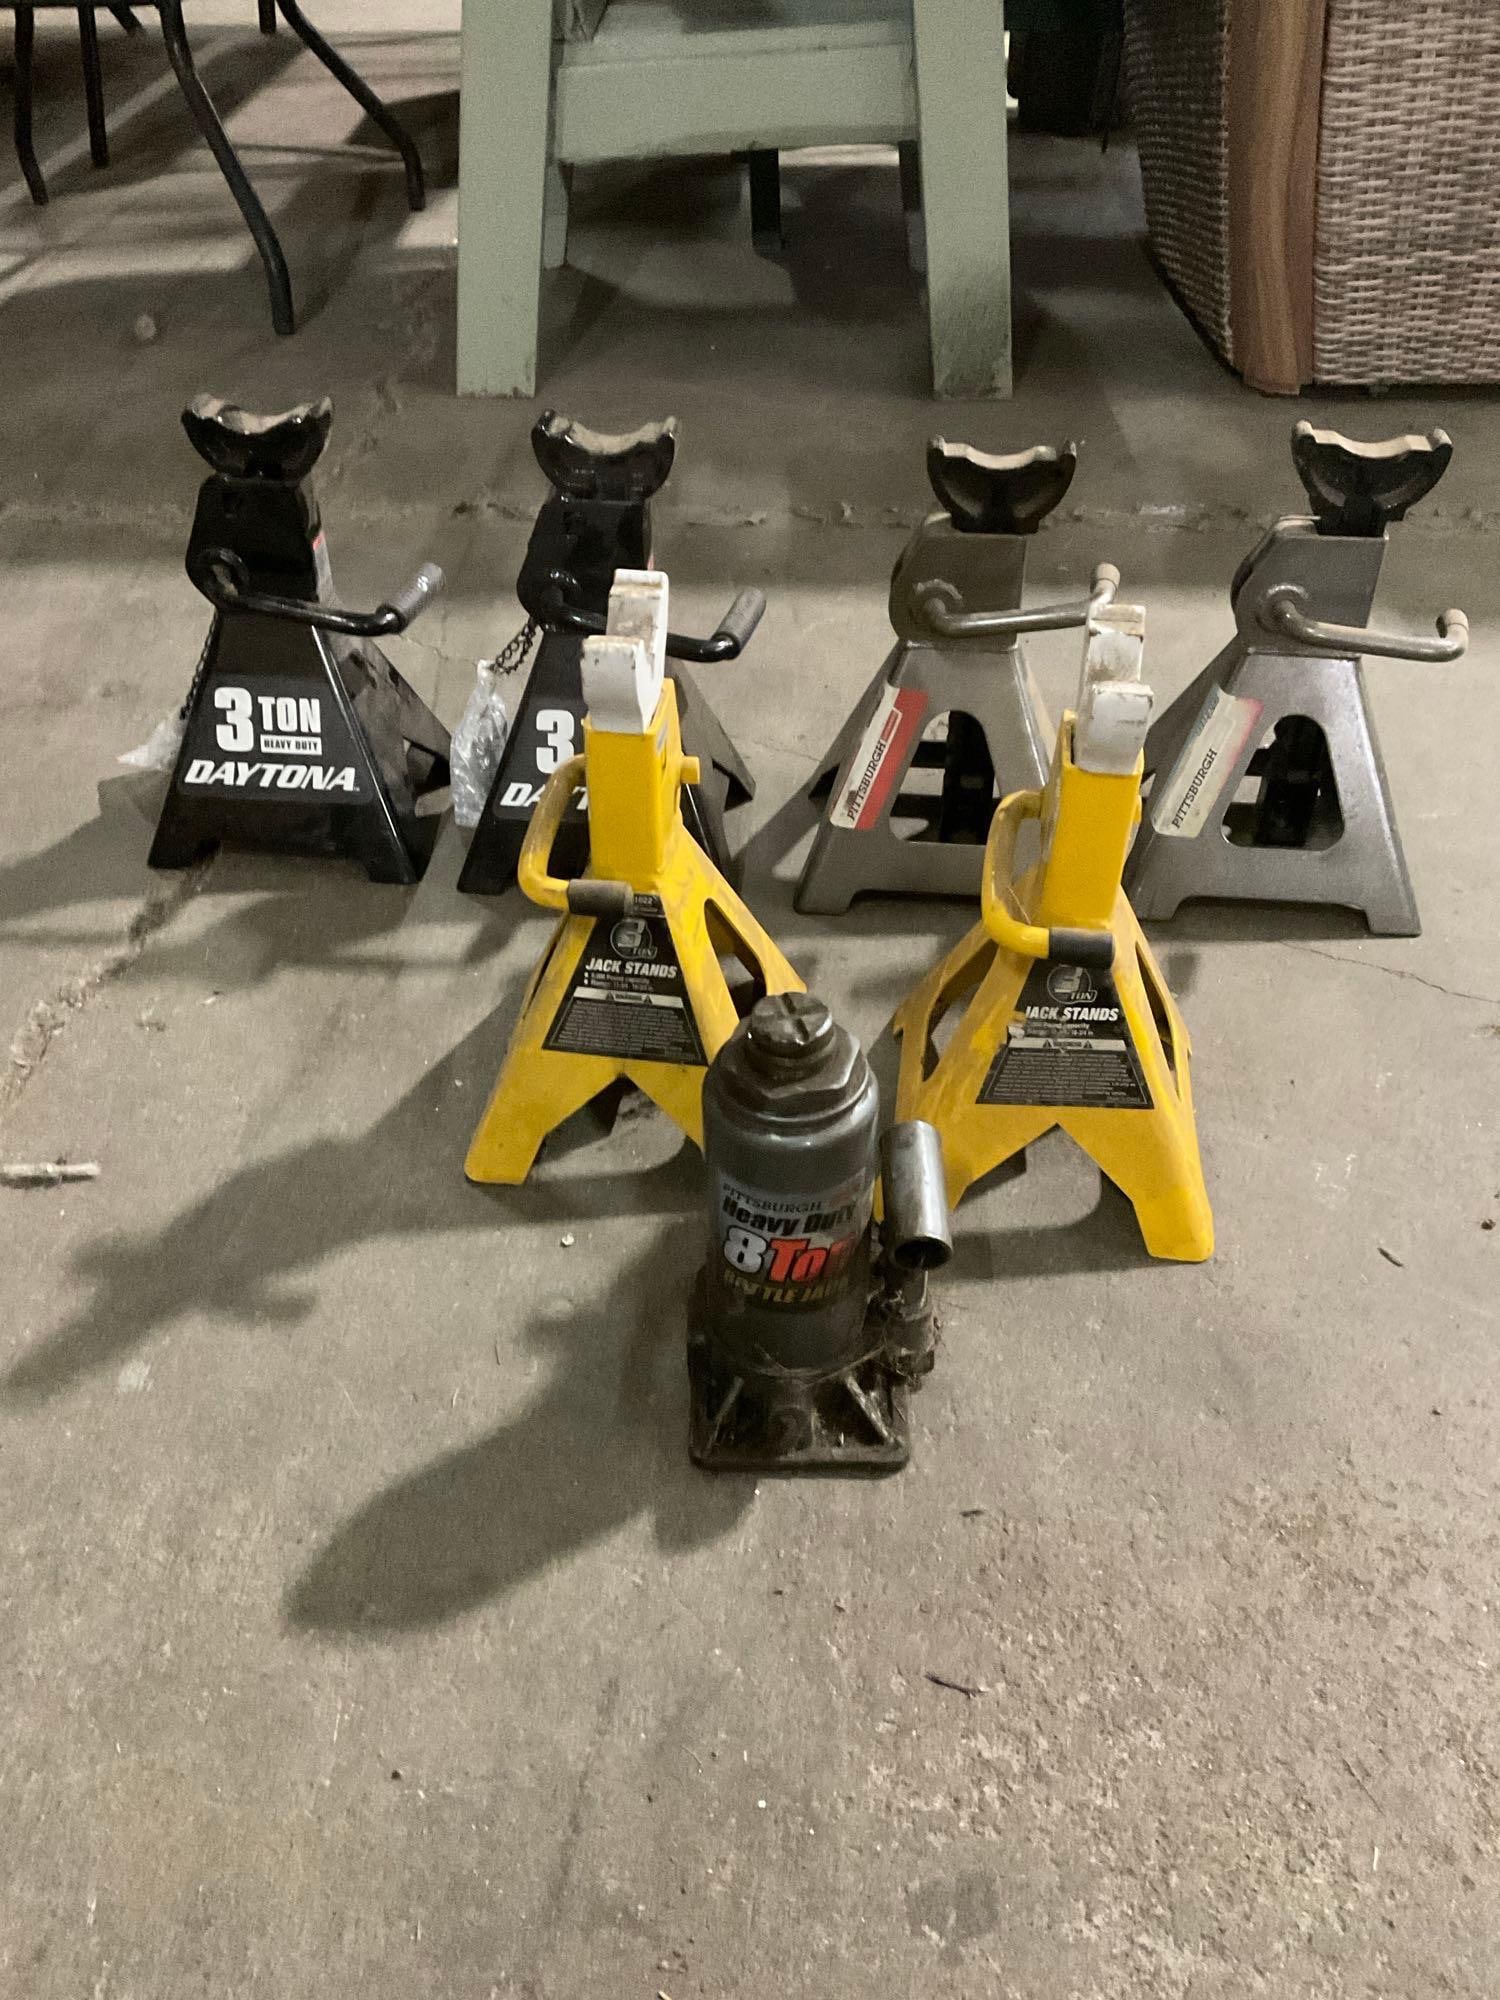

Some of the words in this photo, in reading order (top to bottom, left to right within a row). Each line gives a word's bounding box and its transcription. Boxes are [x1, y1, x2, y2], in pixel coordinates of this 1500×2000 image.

[214, 686, 254, 752] 3
[257, 696, 322, 733] TON
[263, 738, 292, 750] HEAVY
[295, 740, 319, 752] DUTY
[536, 709, 575, 774] 3
[184, 759, 356, 792] DAYTONA
[847, 738, 887, 821] PITTSBURGH
[1171, 748, 1218, 830] PITTSBURGH
[585, 957, 622, 973] JACK
[625, 961, 678, 979] STANDS
[1062, 1006, 1119, 1021] STANDS
[722, 1196, 800, 1236] Heavy
[723, 1183, 823, 1214] PITTSBURGH
[723, 1225, 769, 1274] 8
